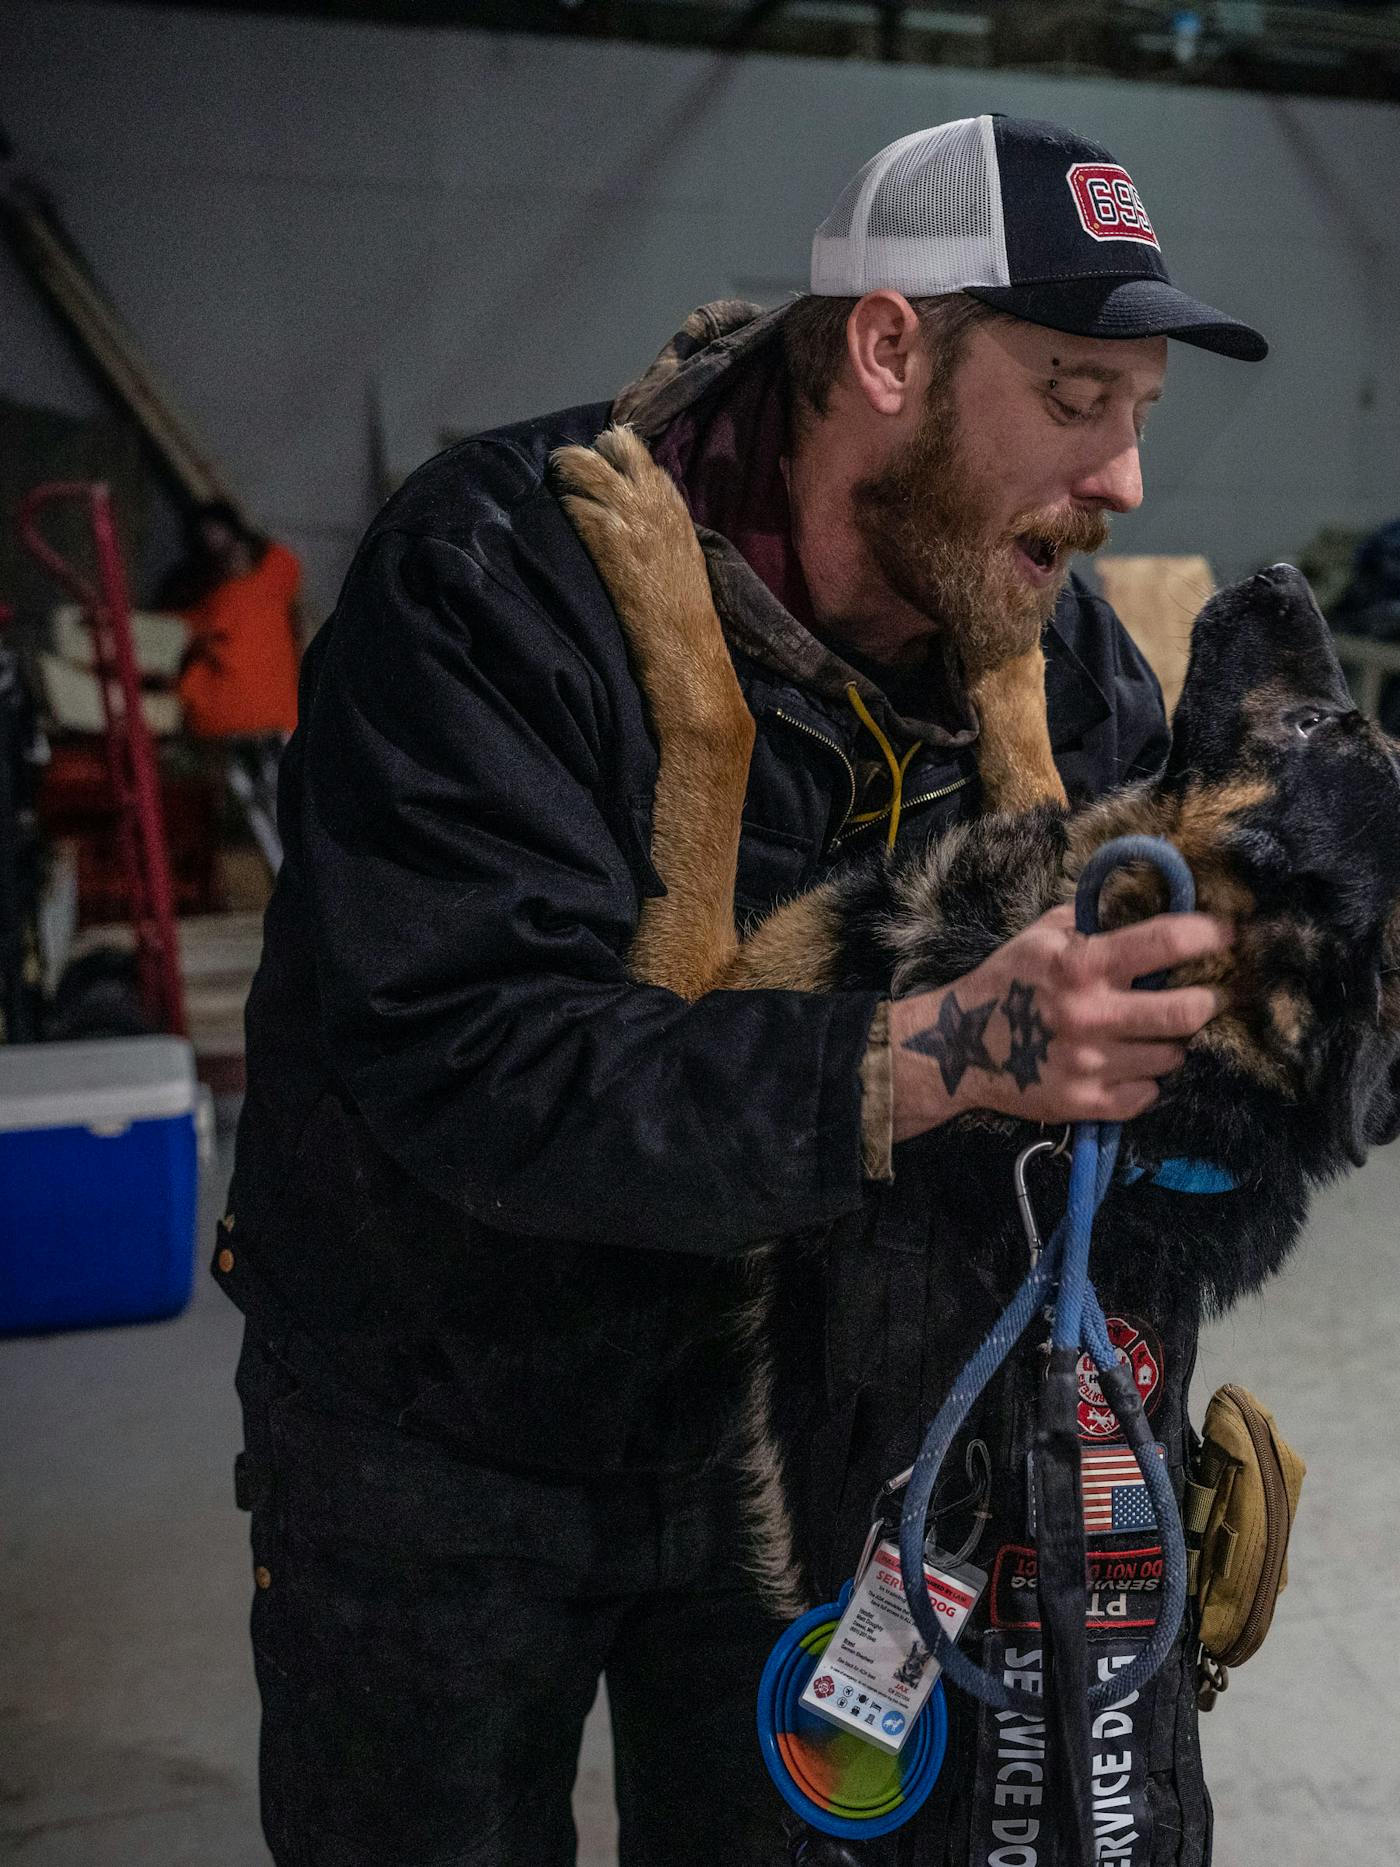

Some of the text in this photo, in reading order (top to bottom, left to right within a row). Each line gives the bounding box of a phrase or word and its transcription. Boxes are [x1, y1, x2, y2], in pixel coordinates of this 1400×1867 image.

[1106, 1561, 1137, 1579] NOT
[1140, 1559, 1163, 1577] DO
[876, 1570, 906, 1591] SERV
[894, 1682, 909, 1694] JAX
[988, 1818, 1041, 1867] DO
